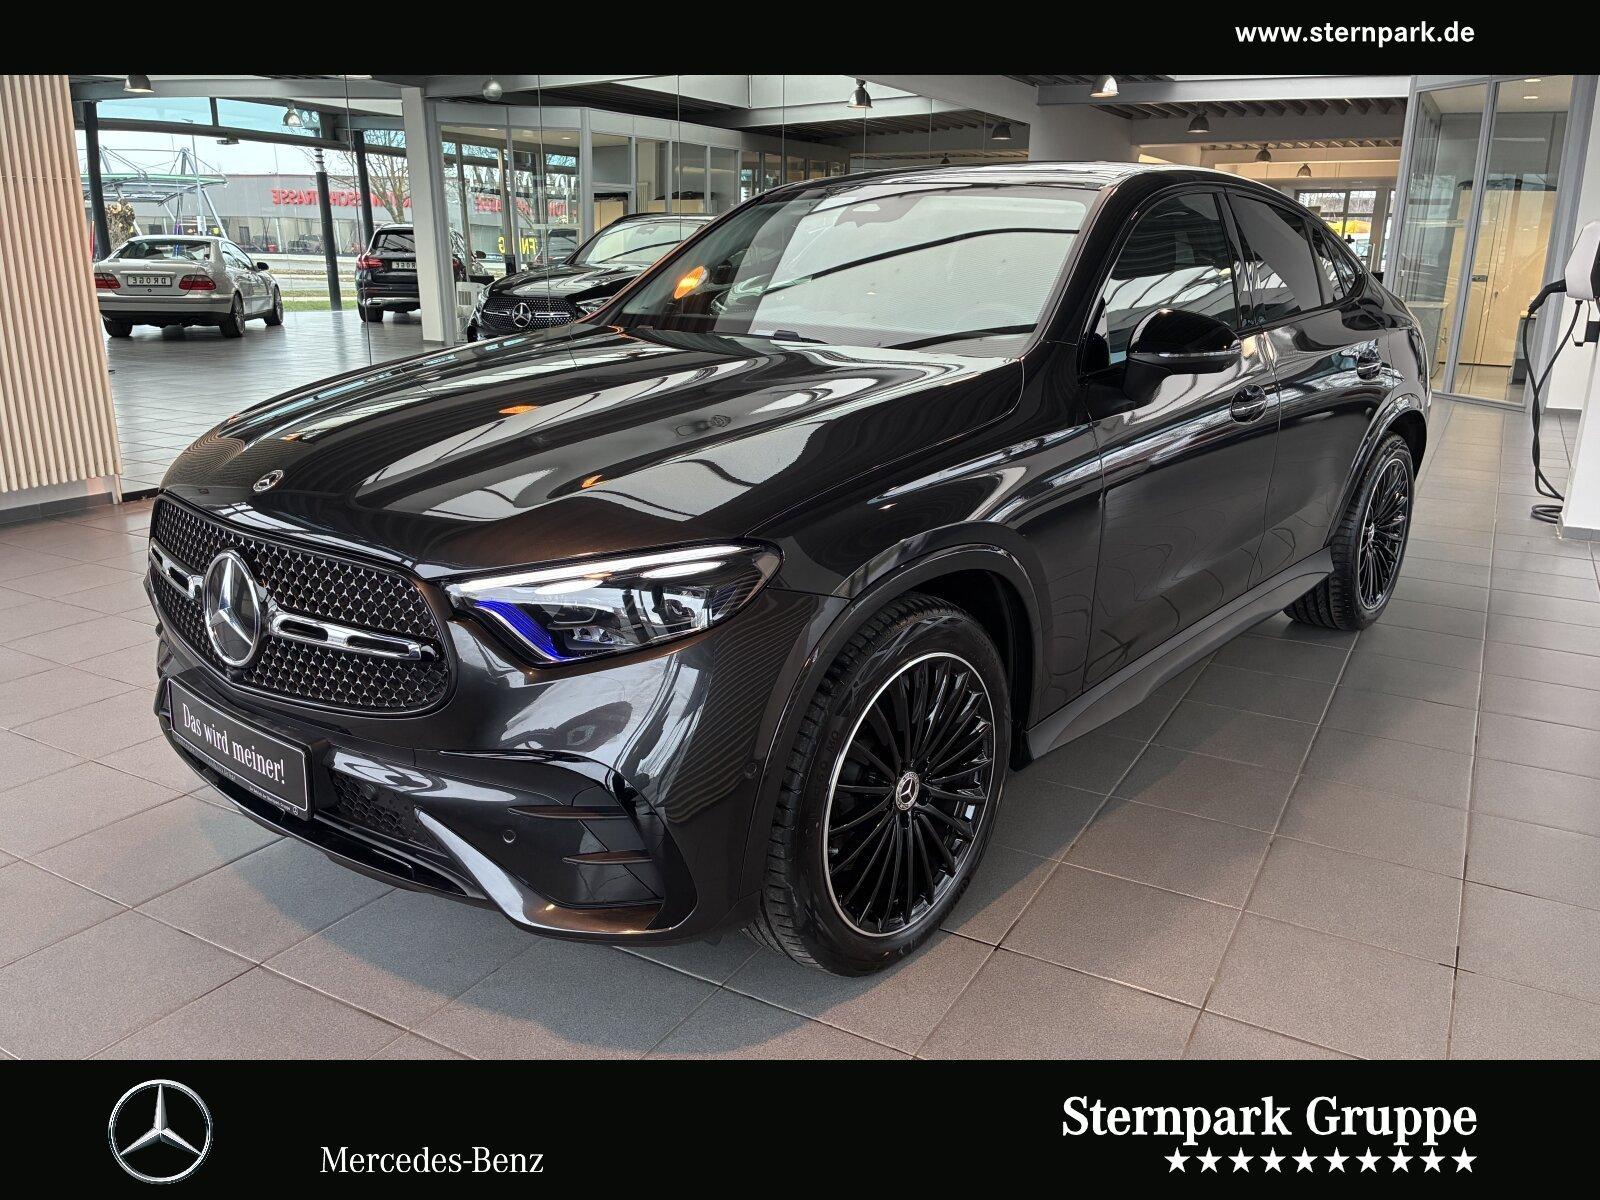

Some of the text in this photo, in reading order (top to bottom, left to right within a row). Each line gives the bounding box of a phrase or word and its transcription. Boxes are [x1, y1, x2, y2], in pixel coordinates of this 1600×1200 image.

[183, 703, 202, 737] Das
[203, 723, 230, 755] wird
[232, 741, 285, 785] meiner!
